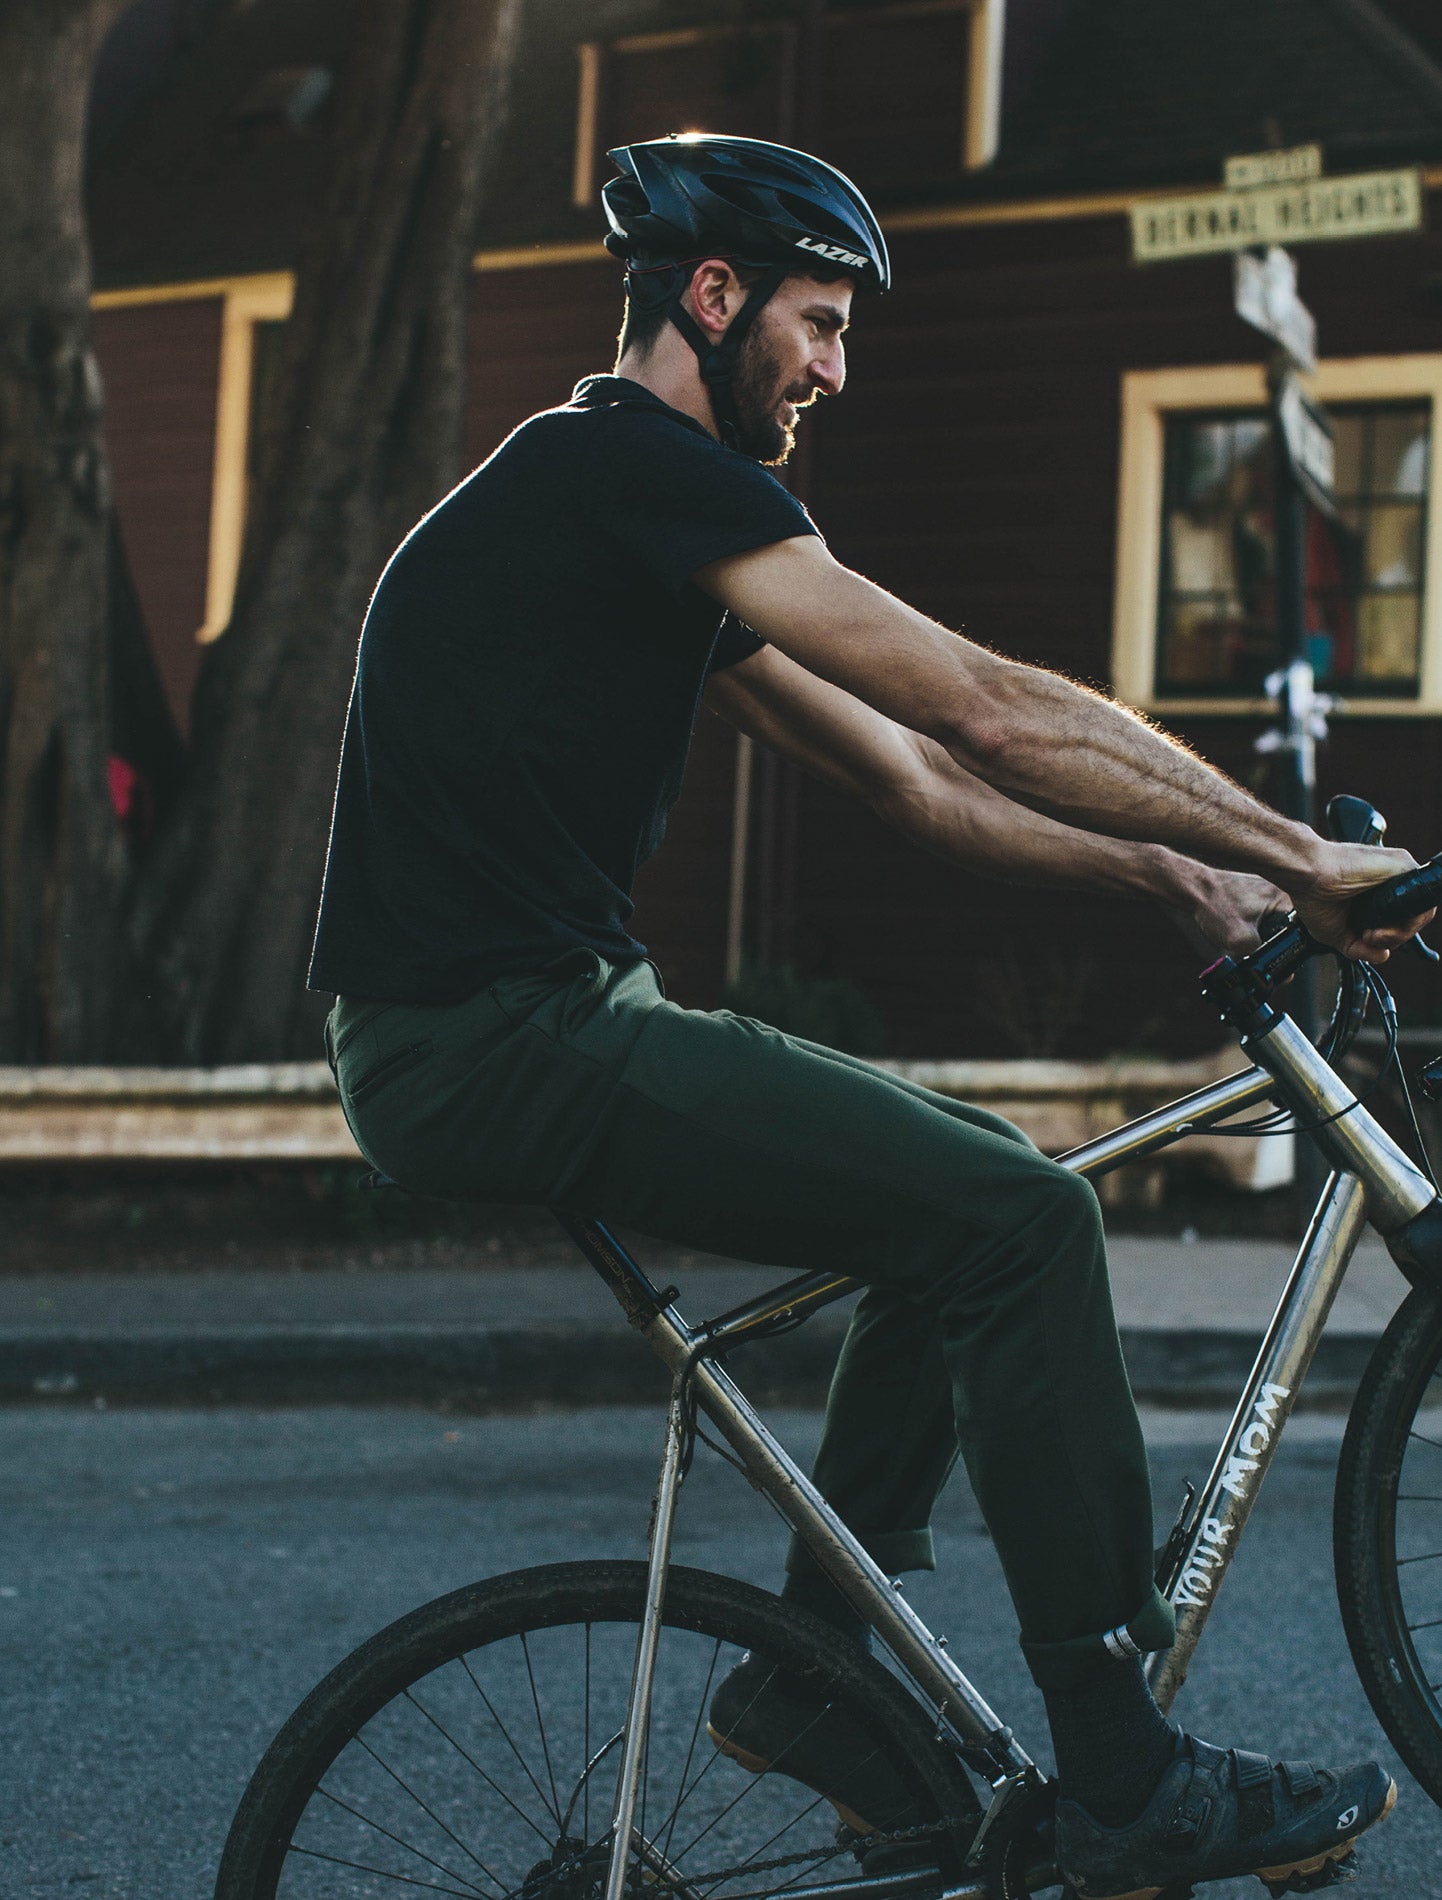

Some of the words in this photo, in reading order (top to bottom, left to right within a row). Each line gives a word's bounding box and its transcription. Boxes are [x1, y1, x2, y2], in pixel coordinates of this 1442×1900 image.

[794, 236, 869, 269] LAZER
[575, 1218, 631, 1283] HOMSON
[1175, 1517, 1236, 1606] YOUR
[1221, 1382, 1291, 1499] MOM
